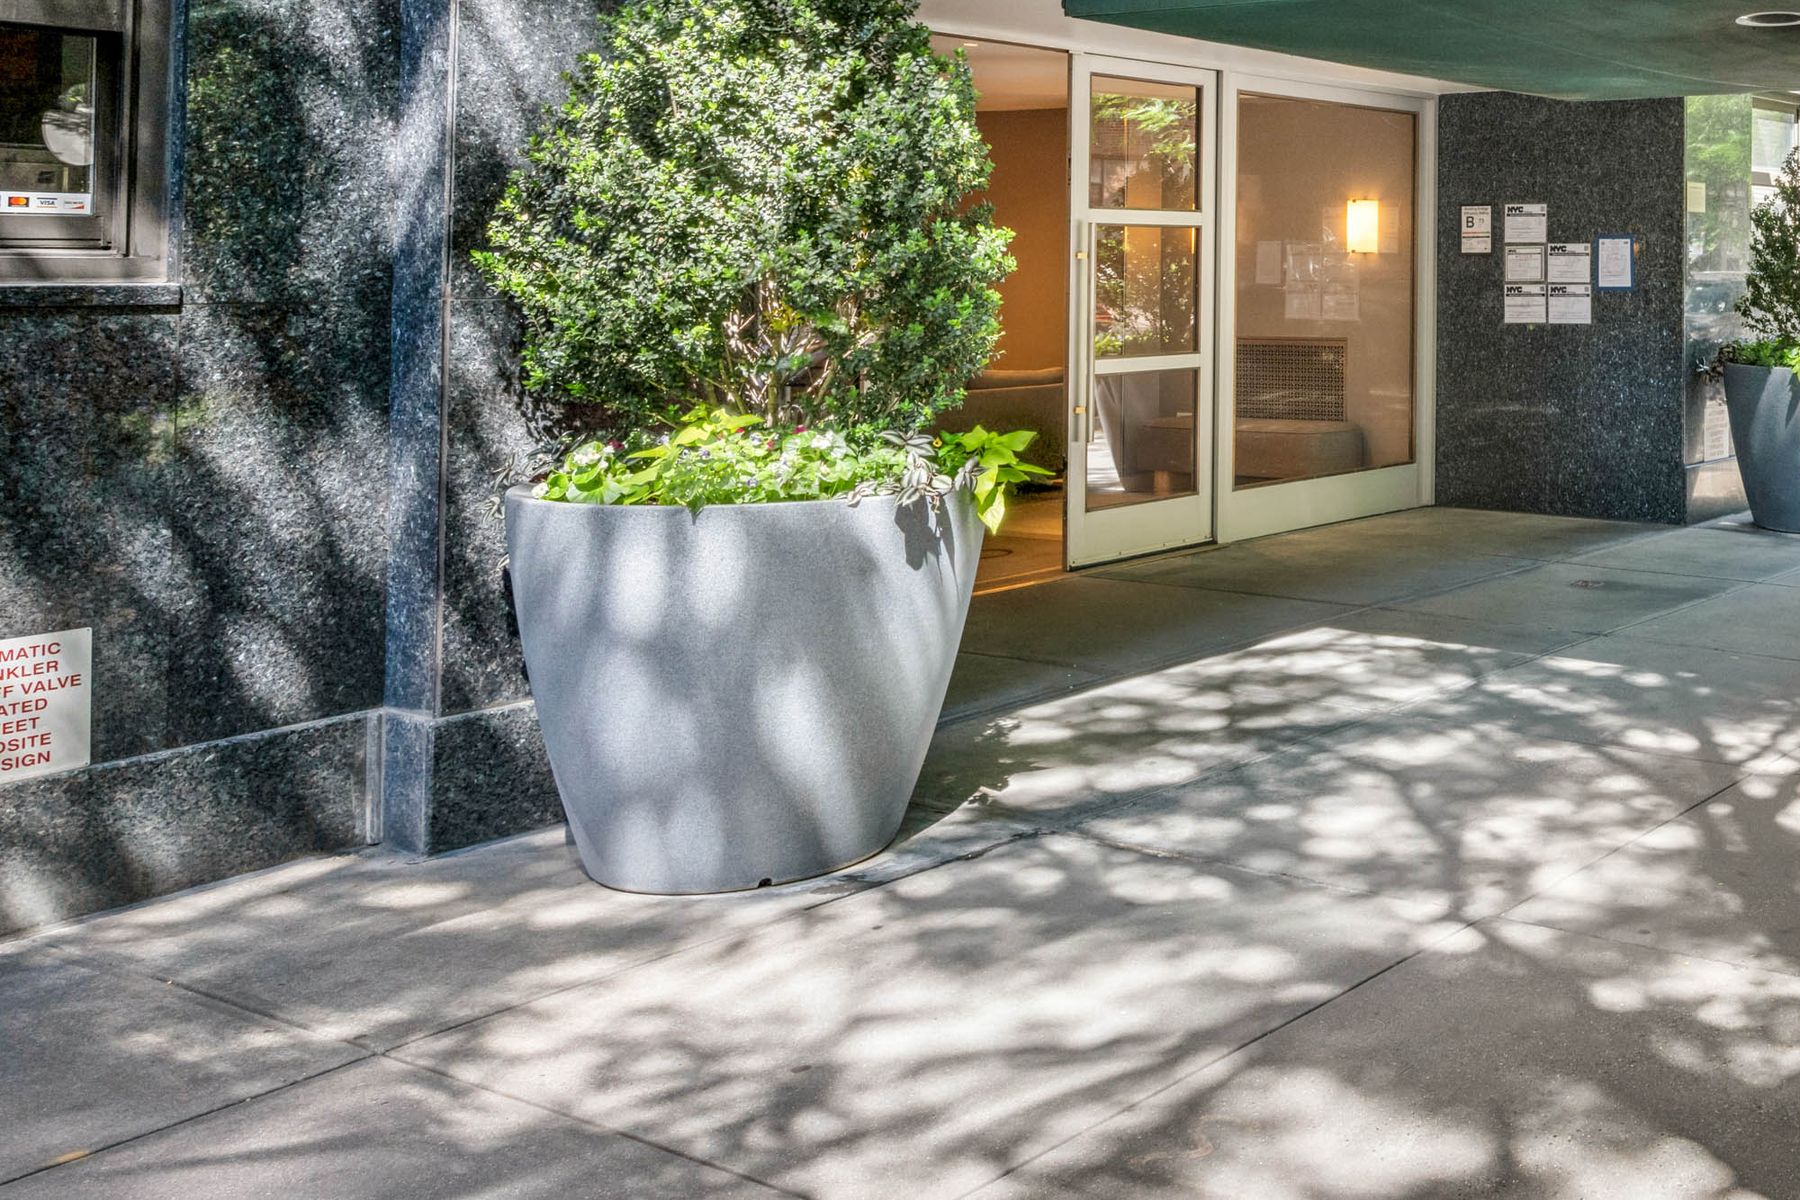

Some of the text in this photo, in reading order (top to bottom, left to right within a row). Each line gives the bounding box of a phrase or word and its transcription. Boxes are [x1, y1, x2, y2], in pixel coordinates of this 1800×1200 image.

[1466, 216, 1475, 228] B
[0, 642, 61, 662] MATIC
[21, 673, 82, 695] VALVE
[1, 751, 50, 771] SIGN
